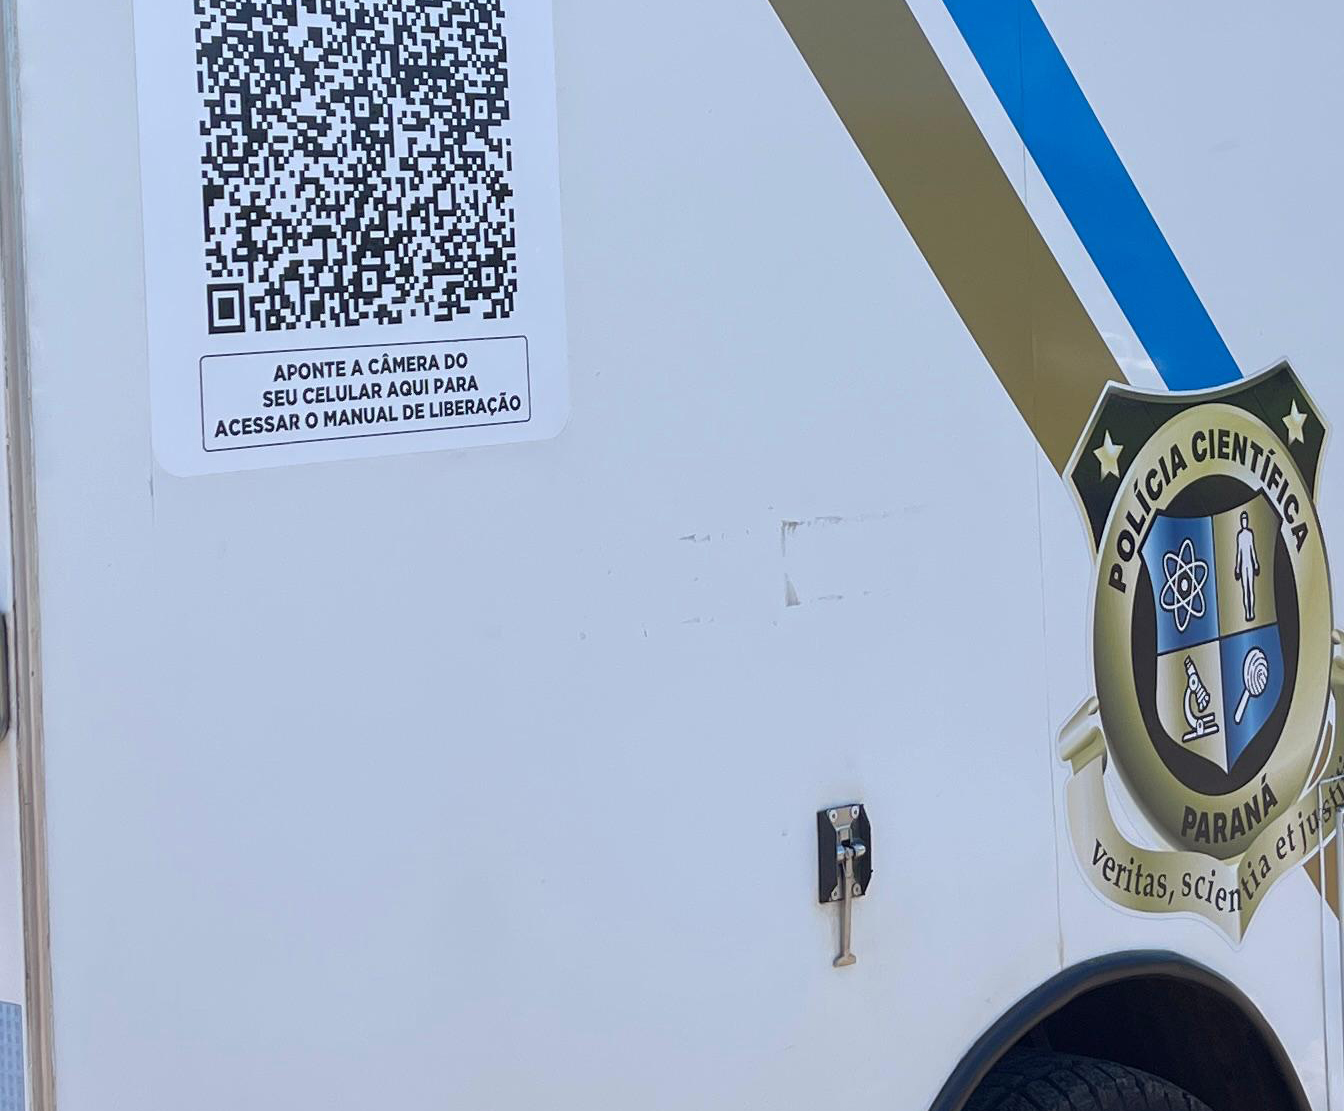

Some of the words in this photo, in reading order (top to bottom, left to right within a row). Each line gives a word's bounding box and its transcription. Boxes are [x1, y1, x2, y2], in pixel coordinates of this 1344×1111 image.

[262, 390, 297, 408] SEU
[302, 382, 382, 404] CELULAR
[387, 378, 429, 397] AQUI
[434, 375, 479, 393] PARA
[273, 361, 346, 382] APONTE
[350, 359, 364, 376] A
[368, 353, 440, 375] CÂMERA
[444, 352, 468, 369] DO
[214, 414, 299, 438] ACESSAR
[305, 412, 318, 429] O
[323, 405, 398, 427] MANUAL
[402, 403, 424, 420] DE
[429, 392, 521, 415] LIBERAÇÃO
[1108, 443, 1188, 594] POLÍCIA
[1191, 428, 1308, 553] CIENTÍFICA
[1180, 773, 1278, 844] PARANÁ
[1090, 838, 1175, 906] veritas,
[1181, 853, 1272, 913] scientia
[1275, 823, 1297, 860] et
